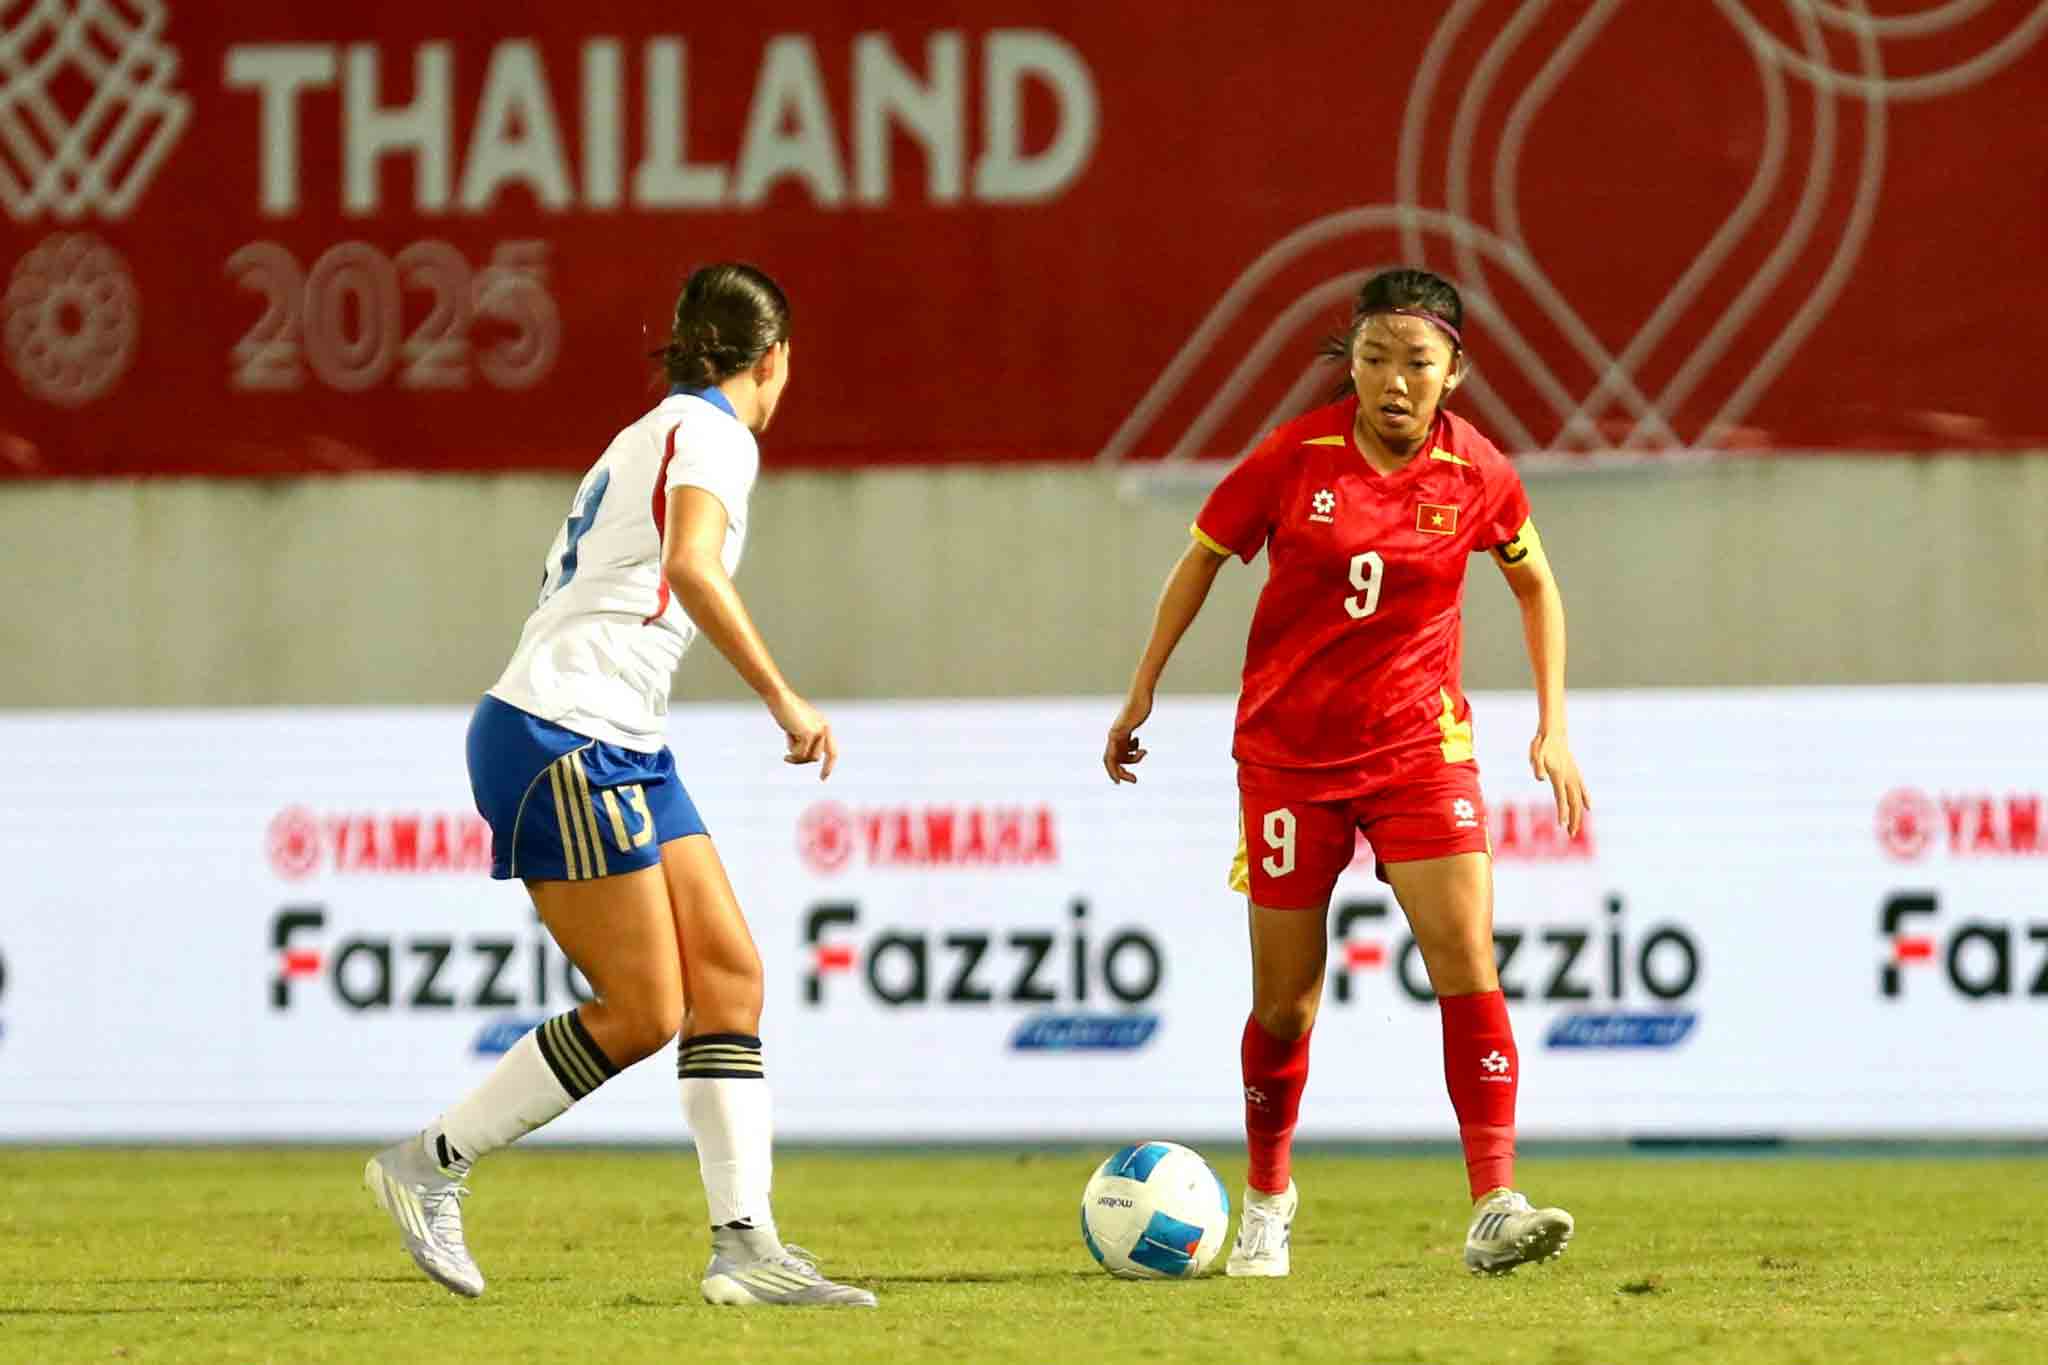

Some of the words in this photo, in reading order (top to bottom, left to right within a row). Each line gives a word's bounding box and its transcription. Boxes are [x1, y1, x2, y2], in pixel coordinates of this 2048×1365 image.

[224, 31, 1098, 213] THAILAND
[226, 240, 562, 392] 2025
[1344, 551, 1384, 619] 9
[602, 784, 652, 853] 13
[860, 804, 1059, 865] YAMAHA
[1262, 808, 1297, 878] 9
[804, 899, 1164, 1006] Fazzio
